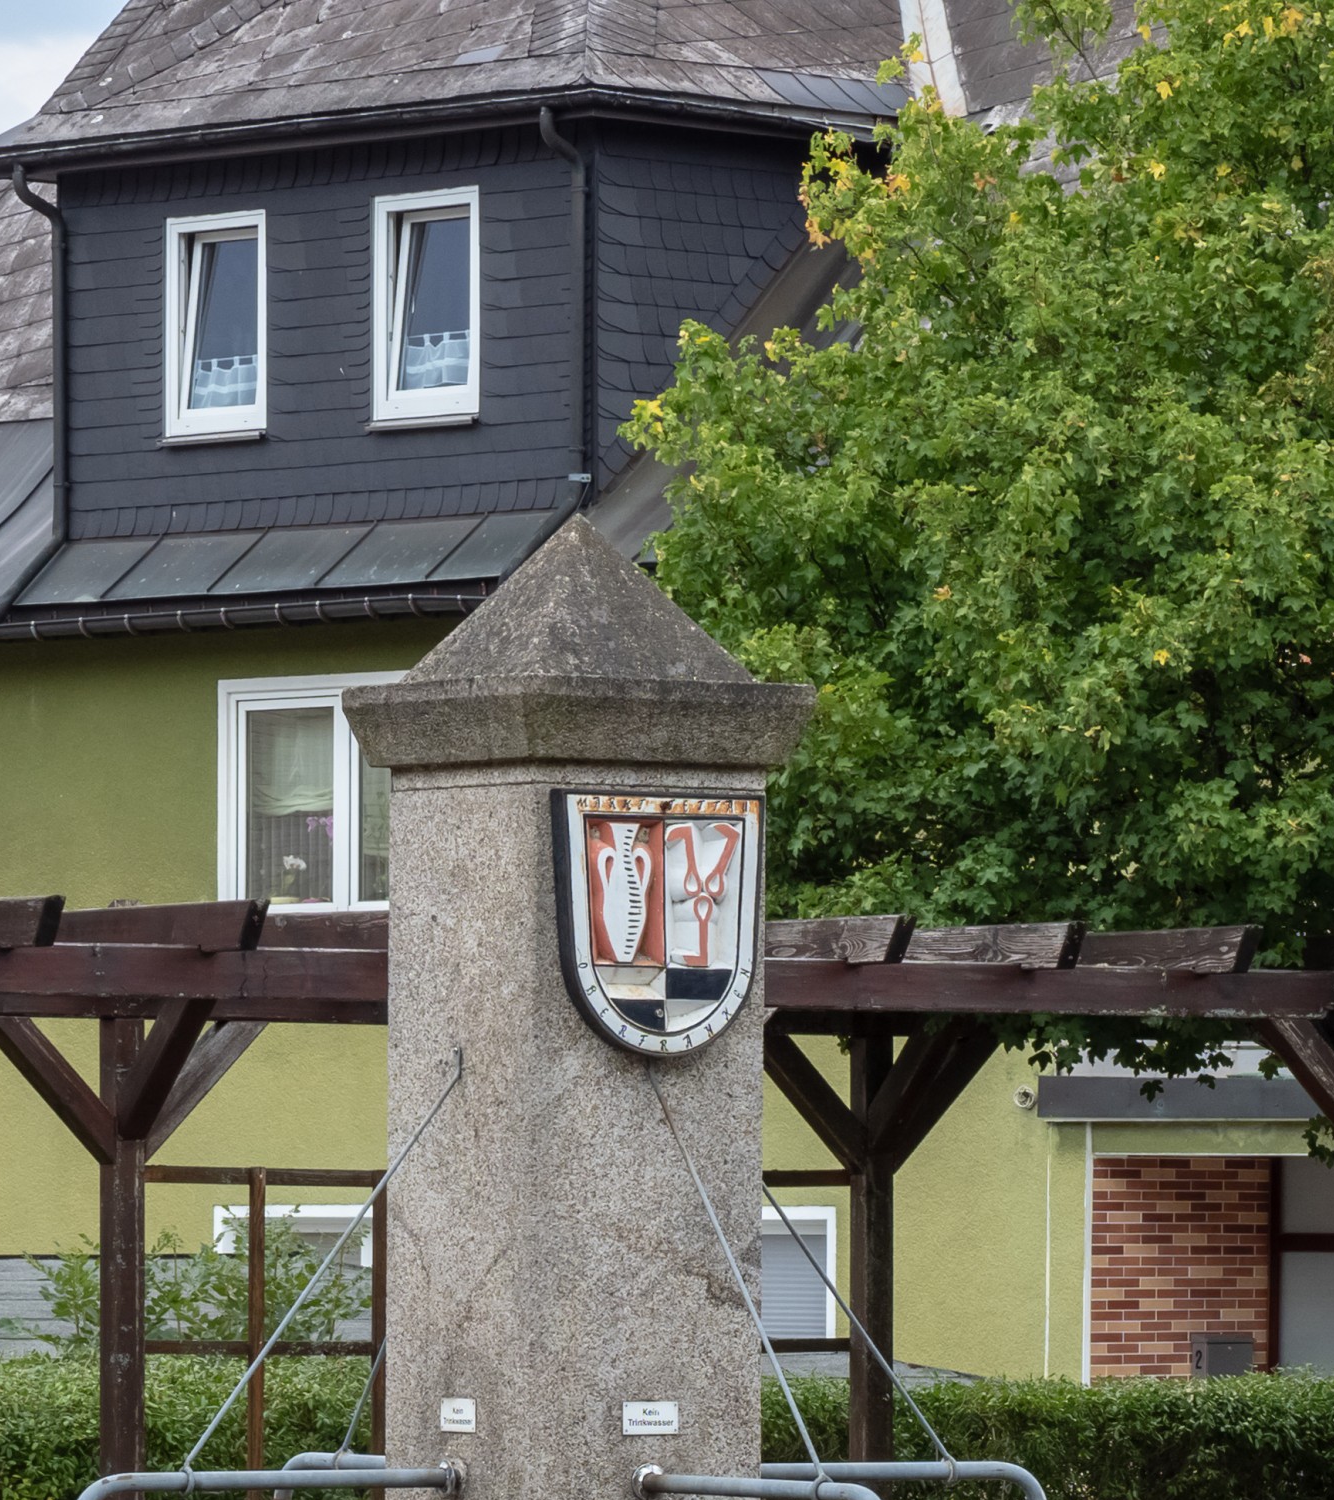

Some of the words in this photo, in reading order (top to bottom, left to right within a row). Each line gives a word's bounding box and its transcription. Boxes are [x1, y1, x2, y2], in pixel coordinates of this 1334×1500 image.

[576, 796, 647, 812] MARKT
[578, 961, 751, 1052] OBERFRANKEN
[1195, 1350, 1202, 1369] 2
[642, 1408, 660, 1416] Kein
[627, 1418, 674, 1426] Trinkwasser
